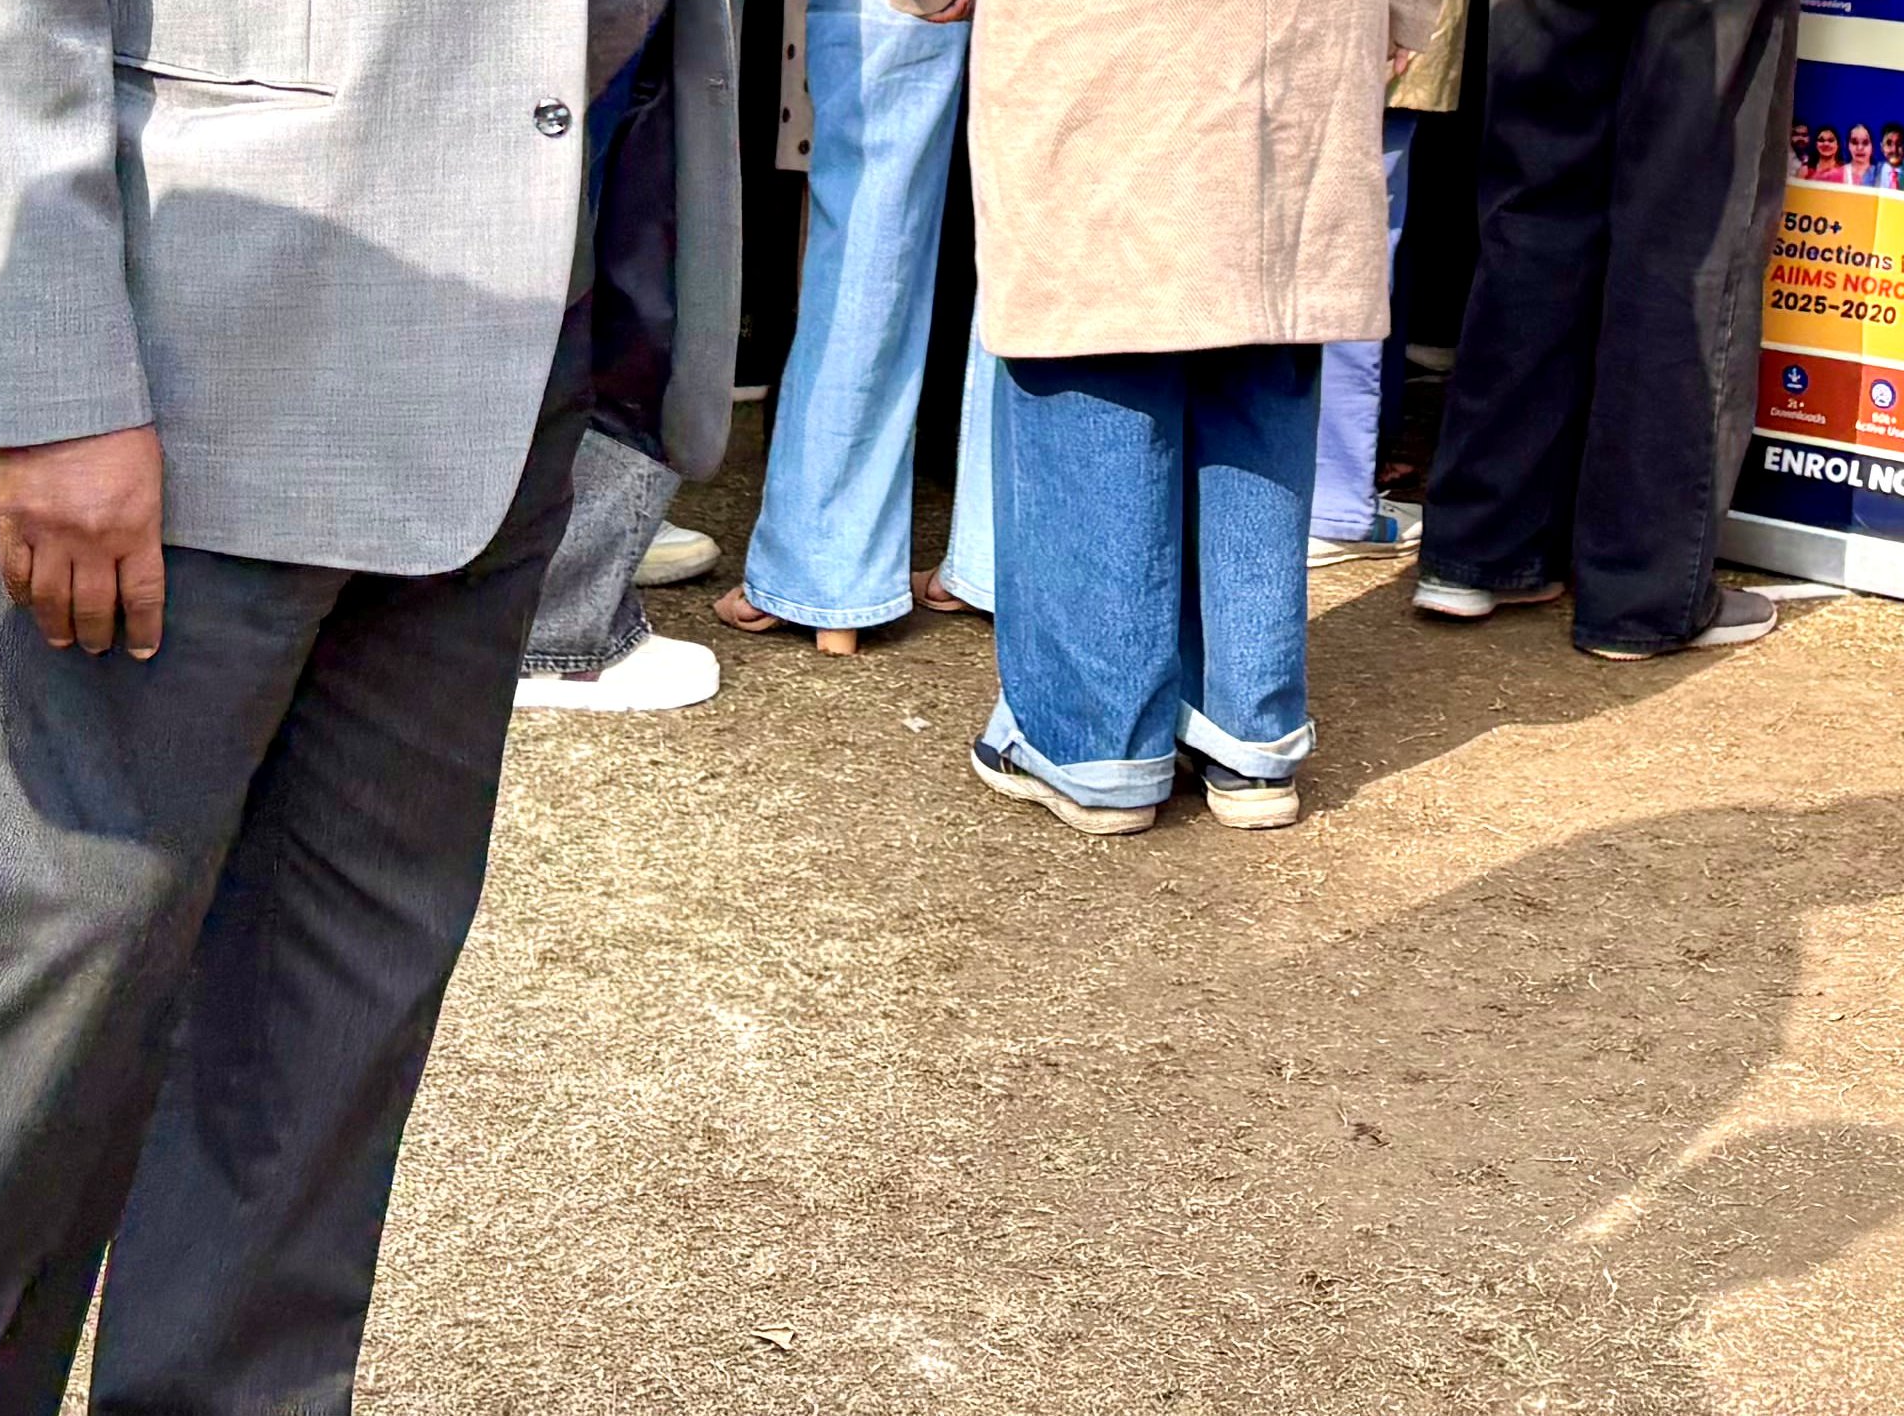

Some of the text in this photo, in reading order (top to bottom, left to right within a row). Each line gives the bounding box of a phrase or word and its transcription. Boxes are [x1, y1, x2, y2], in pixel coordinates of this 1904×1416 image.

[1780, 212, 1842, 236] 500+
[1772, 237, 1894, 271] Selections
[1770, 265, 1838, 290] AIIMS
[1770, 289, 1897, 325] 2025-2020
[1855, 420, 1886, 435] Active
[1764, 445, 1864, 488] ENROL
